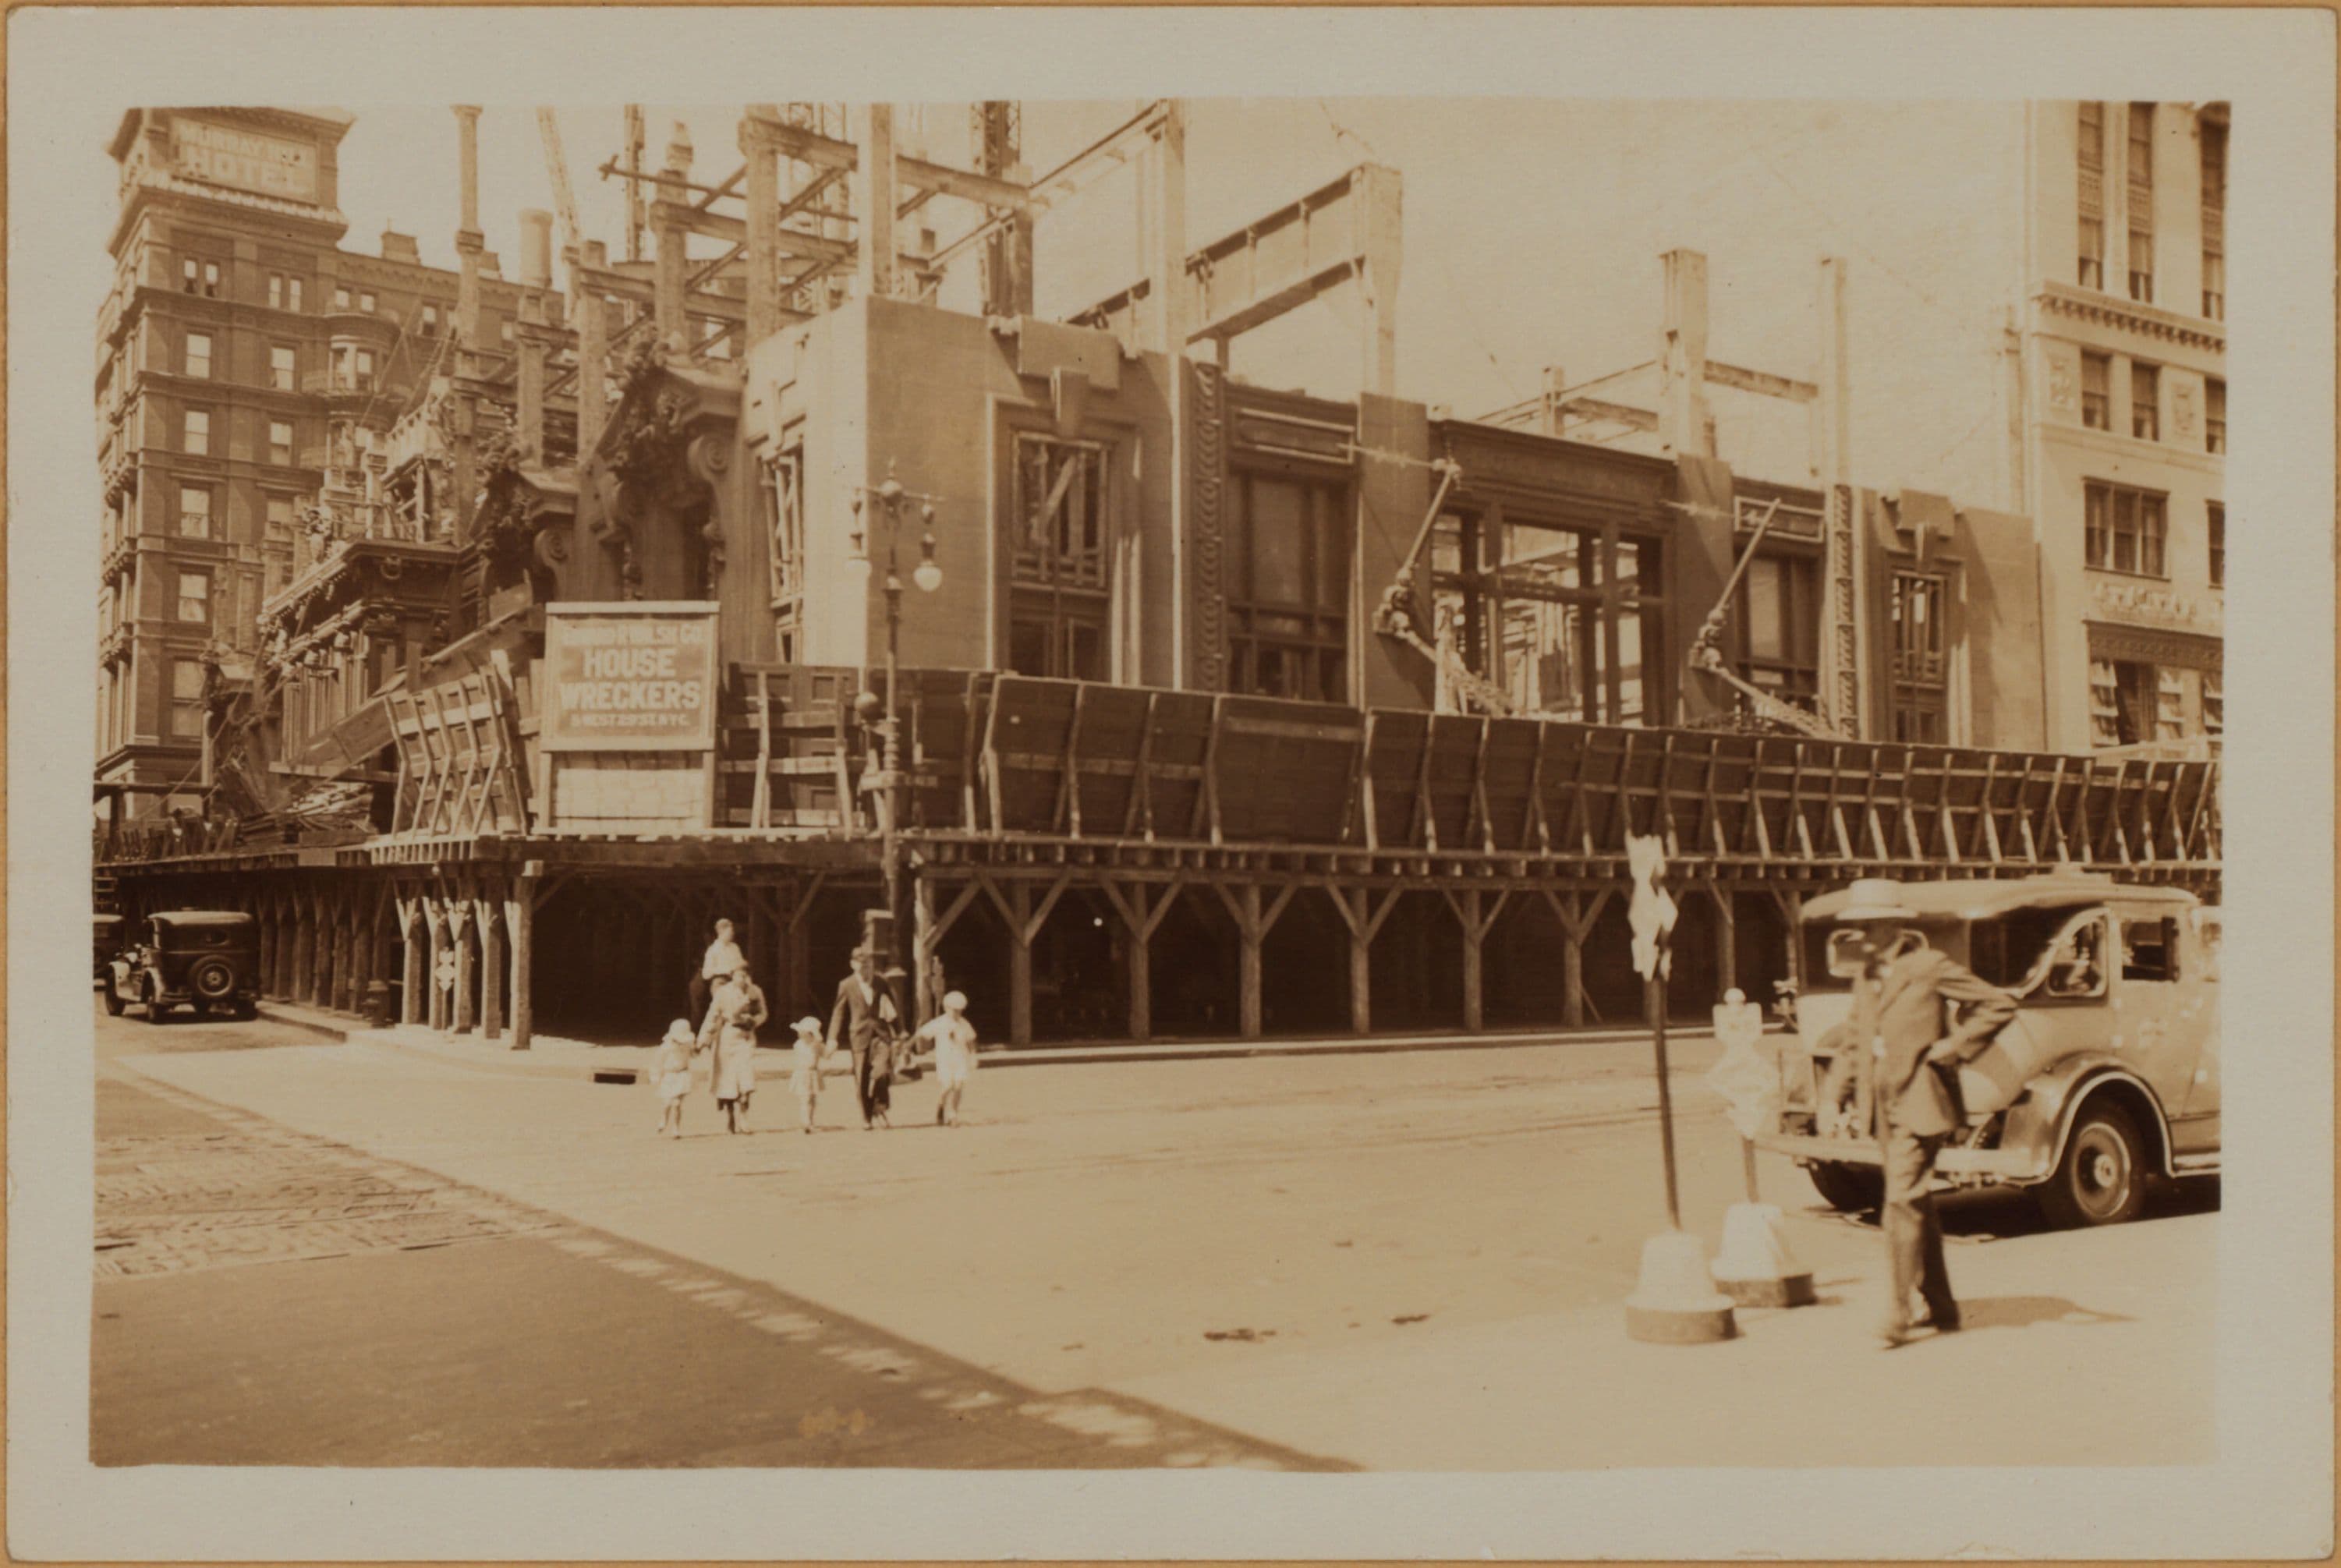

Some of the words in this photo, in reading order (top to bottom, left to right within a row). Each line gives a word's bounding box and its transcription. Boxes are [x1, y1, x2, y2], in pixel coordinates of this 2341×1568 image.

[186, 145, 307, 194] HOTEL
[584, 648, 676, 678] HOUSE
[561, 681, 700, 710] WRECKERS
